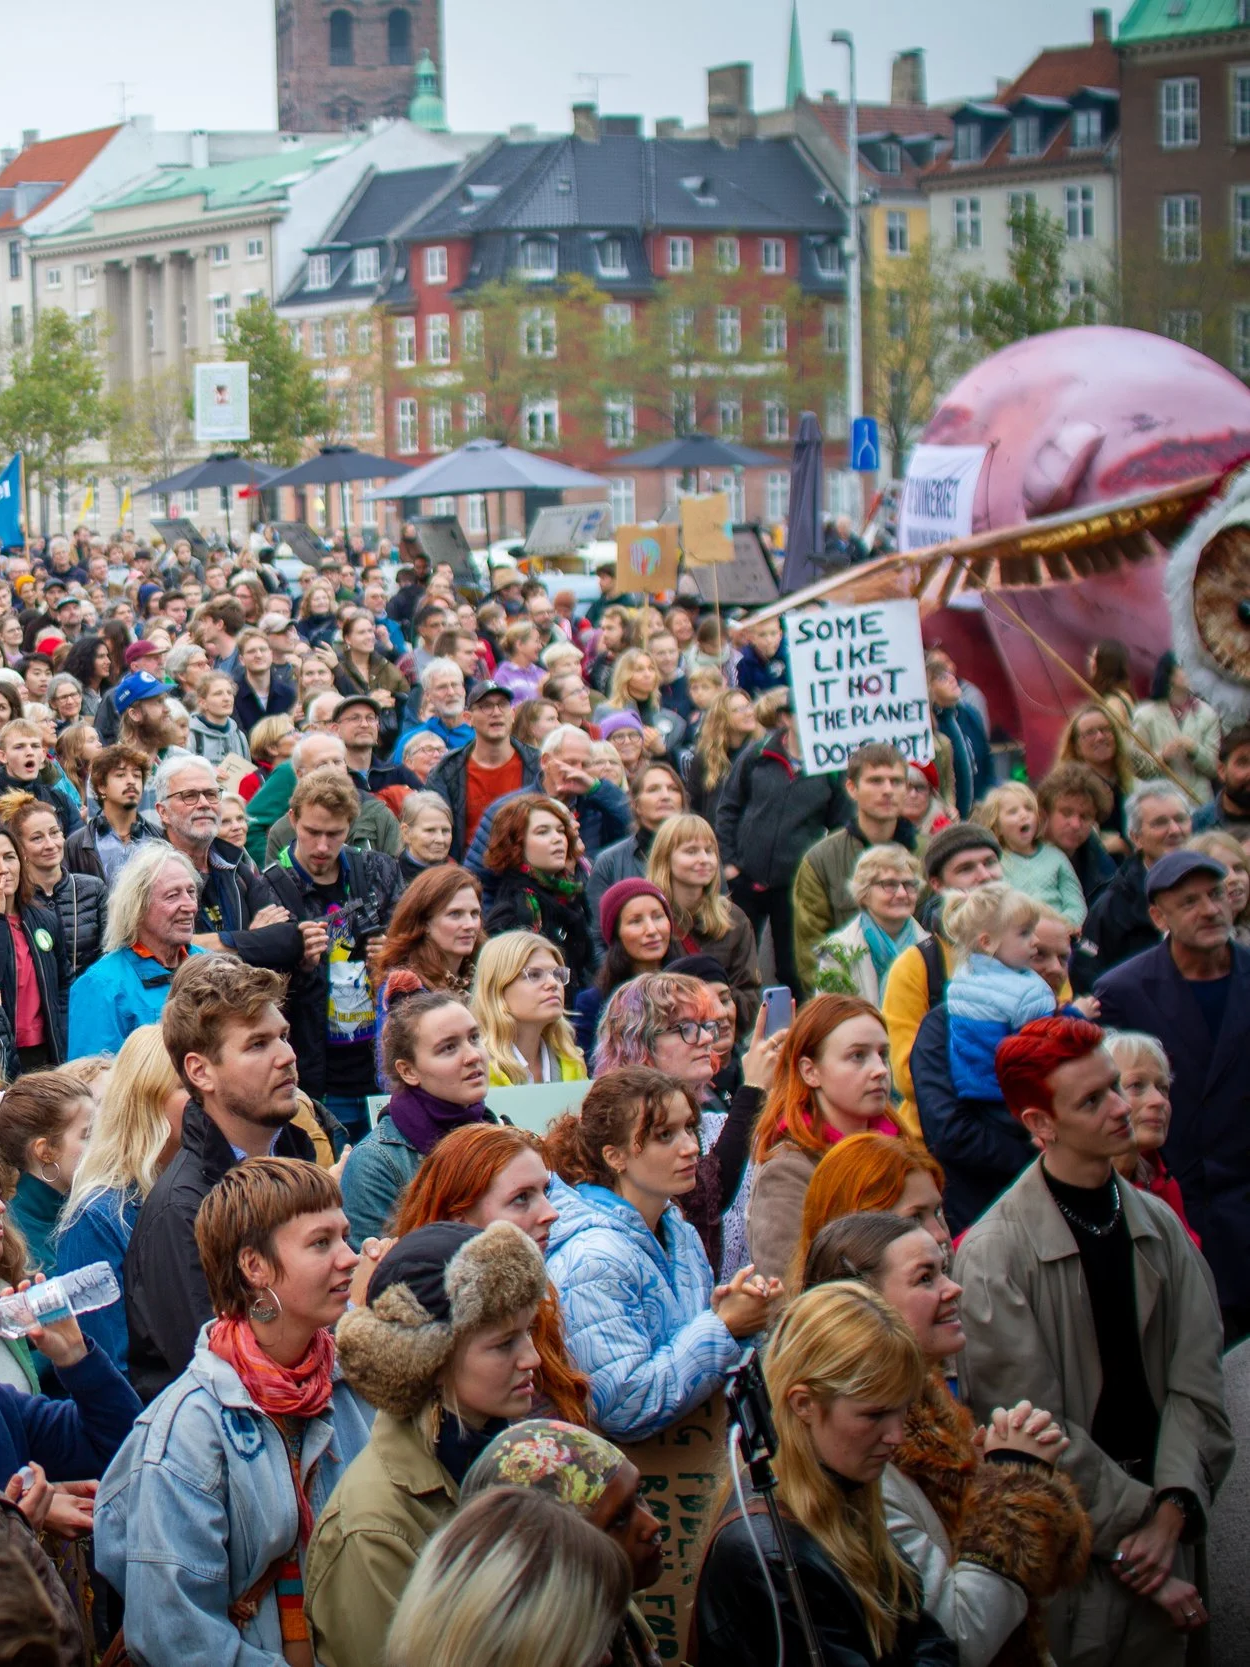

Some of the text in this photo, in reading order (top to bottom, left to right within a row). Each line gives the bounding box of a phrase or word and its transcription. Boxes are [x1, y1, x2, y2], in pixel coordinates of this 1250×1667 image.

[795, 610, 884, 645] SOME
[814, 640, 889, 673] LIKE
[809, 667, 908, 708] IT HOT
[807, 698, 928, 733] THE PLANET
